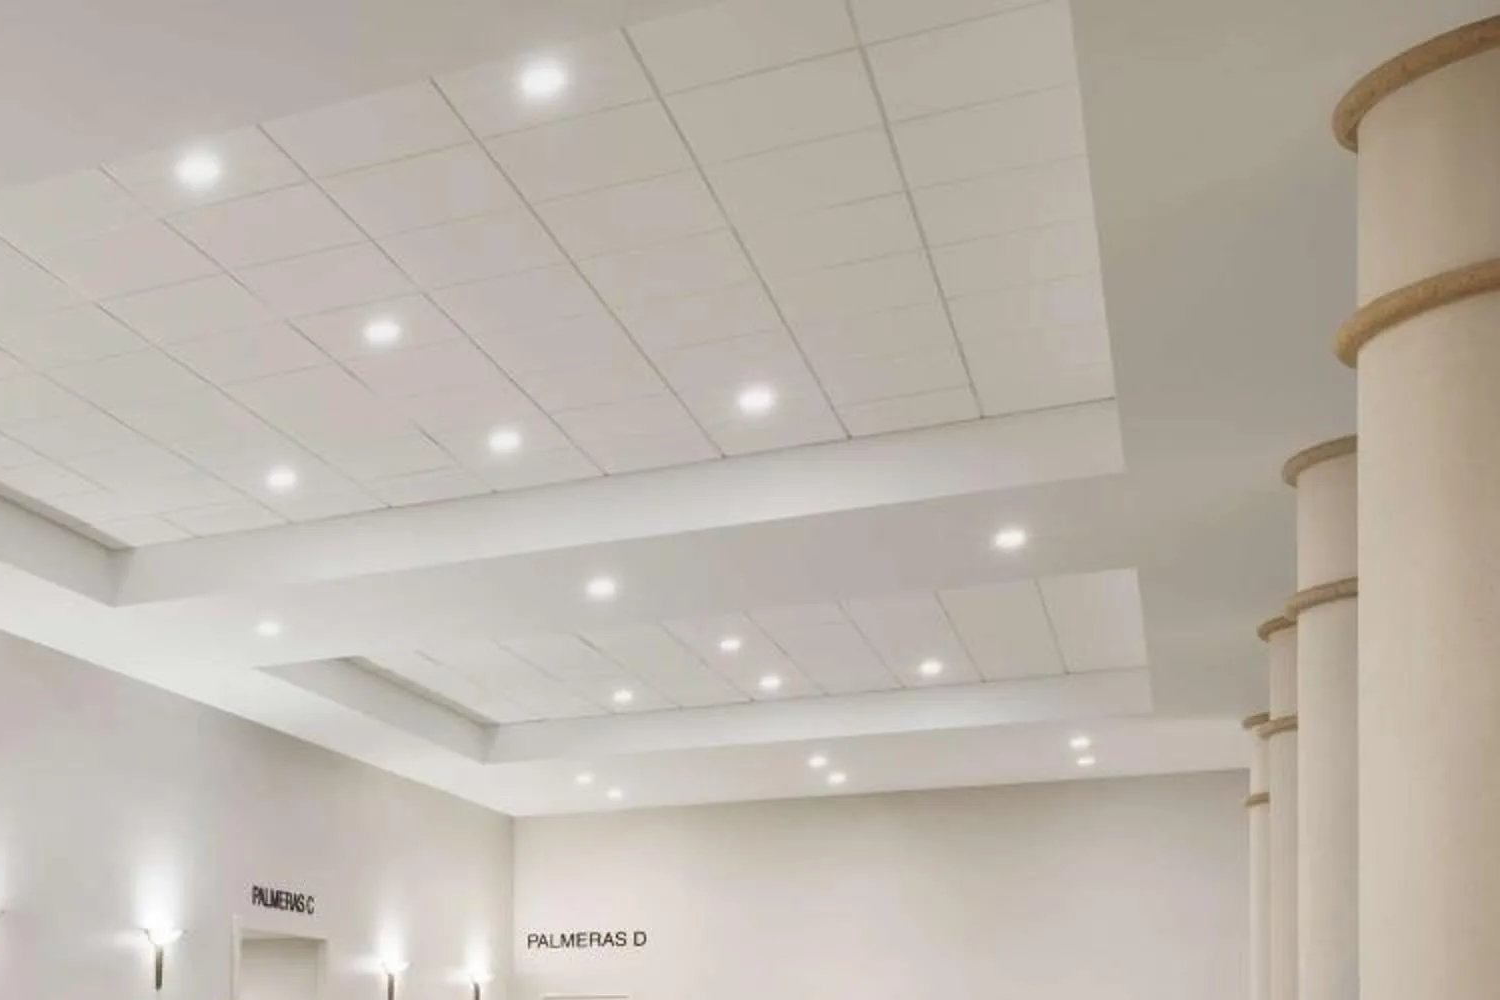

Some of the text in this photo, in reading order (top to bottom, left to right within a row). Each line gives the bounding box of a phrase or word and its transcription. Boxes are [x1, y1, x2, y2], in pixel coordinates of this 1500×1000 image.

[251, 885, 315, 915] PALMERAS C
[527, 931, 647, 949] PALMERAS D
